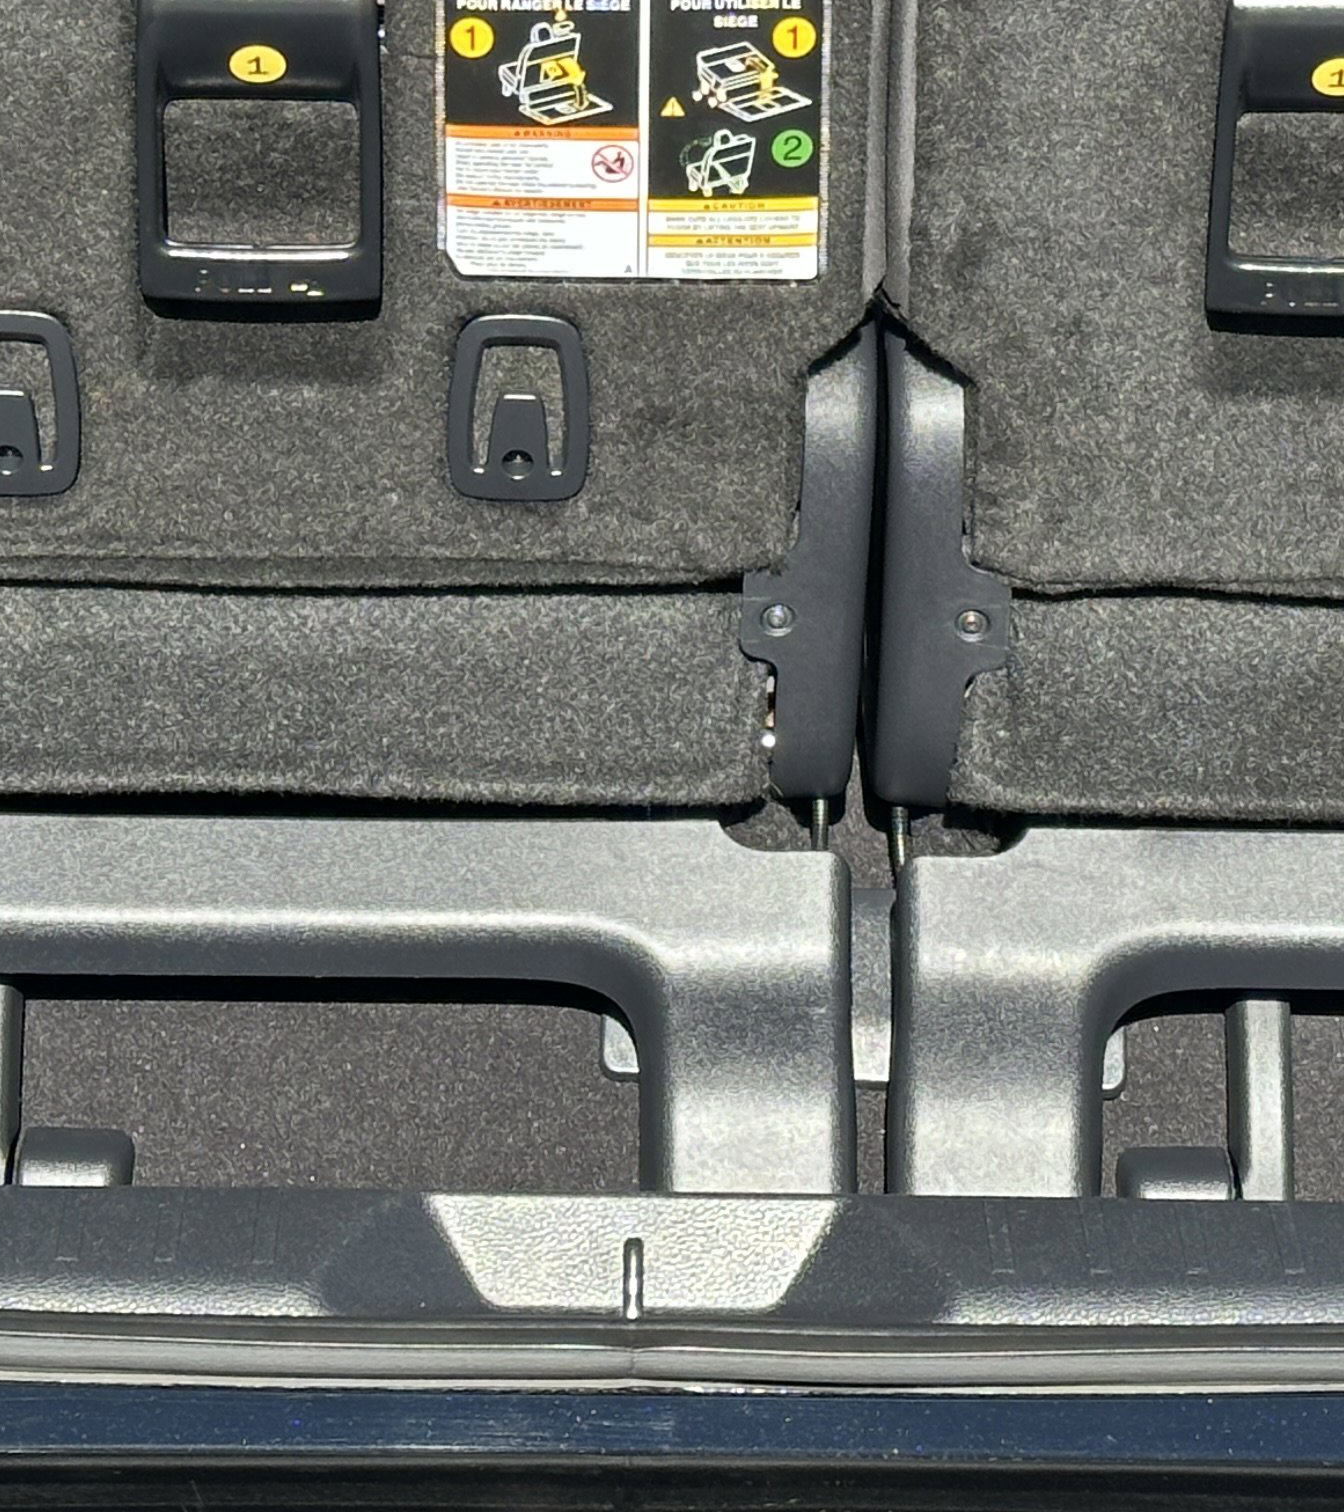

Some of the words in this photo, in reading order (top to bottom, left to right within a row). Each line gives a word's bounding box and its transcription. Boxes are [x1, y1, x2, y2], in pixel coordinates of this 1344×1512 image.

[465, 25, 476, 50] 1
[786, 25, 799, 50] 1
[247, 56, 269, 76] 1
[783, 135, 802, 161] 2
